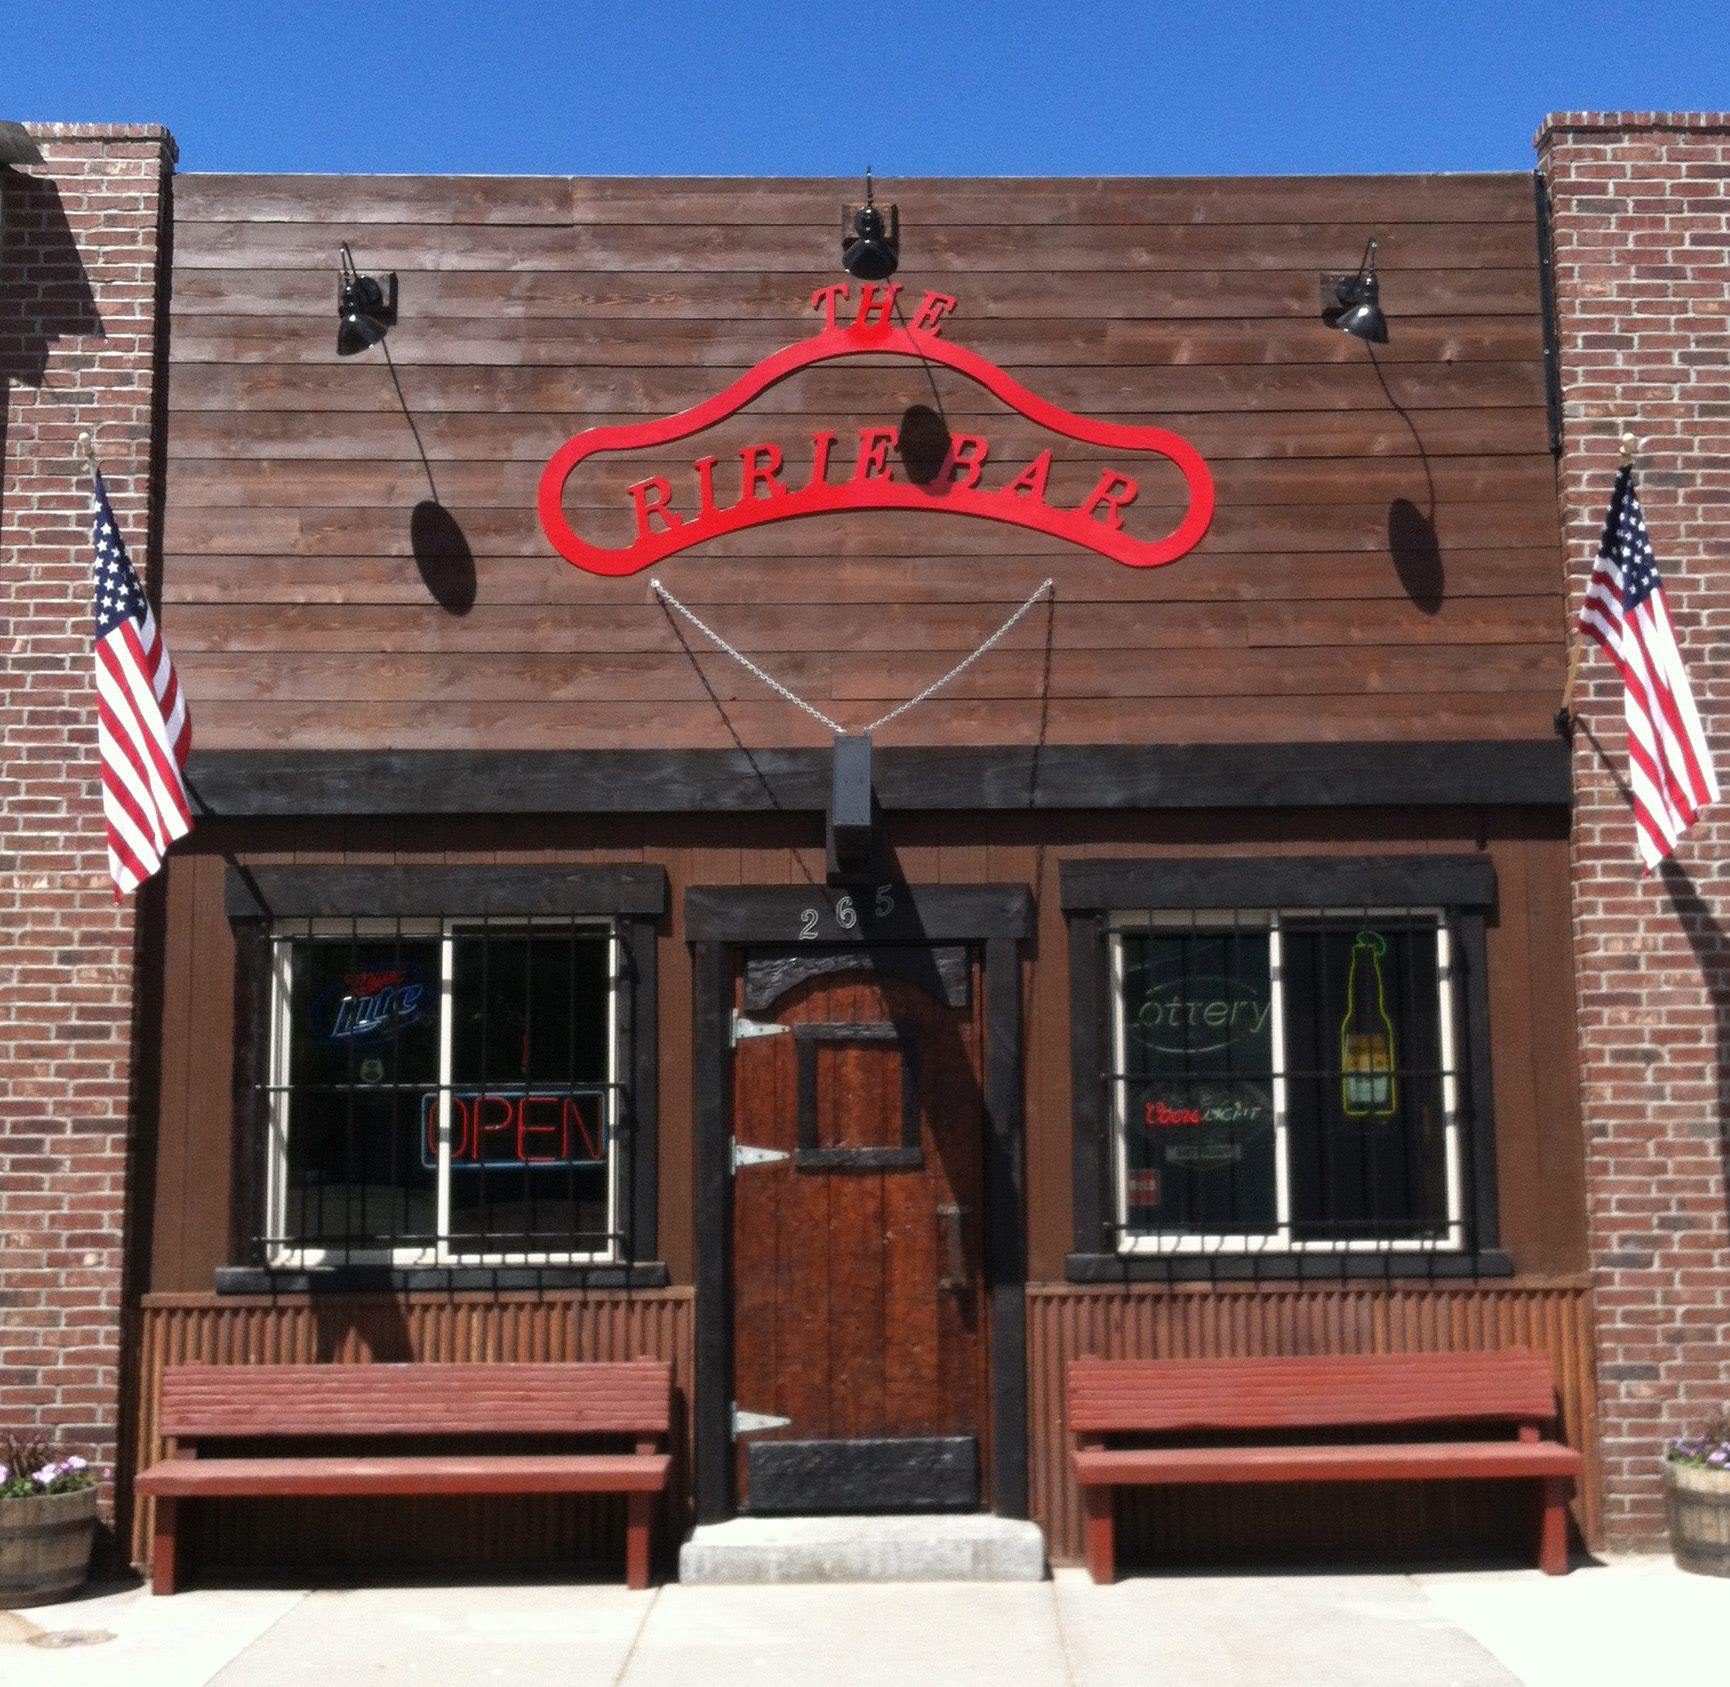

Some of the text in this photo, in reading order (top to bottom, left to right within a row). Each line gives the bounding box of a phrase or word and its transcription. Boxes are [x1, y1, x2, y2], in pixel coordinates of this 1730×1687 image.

[811, 284, 957, 339] THE
[628, 429, 1139, 541] RIRIE BAR
[798, 883, 896, 941] 265
[427, 1096, 604, 1162] OPEN
